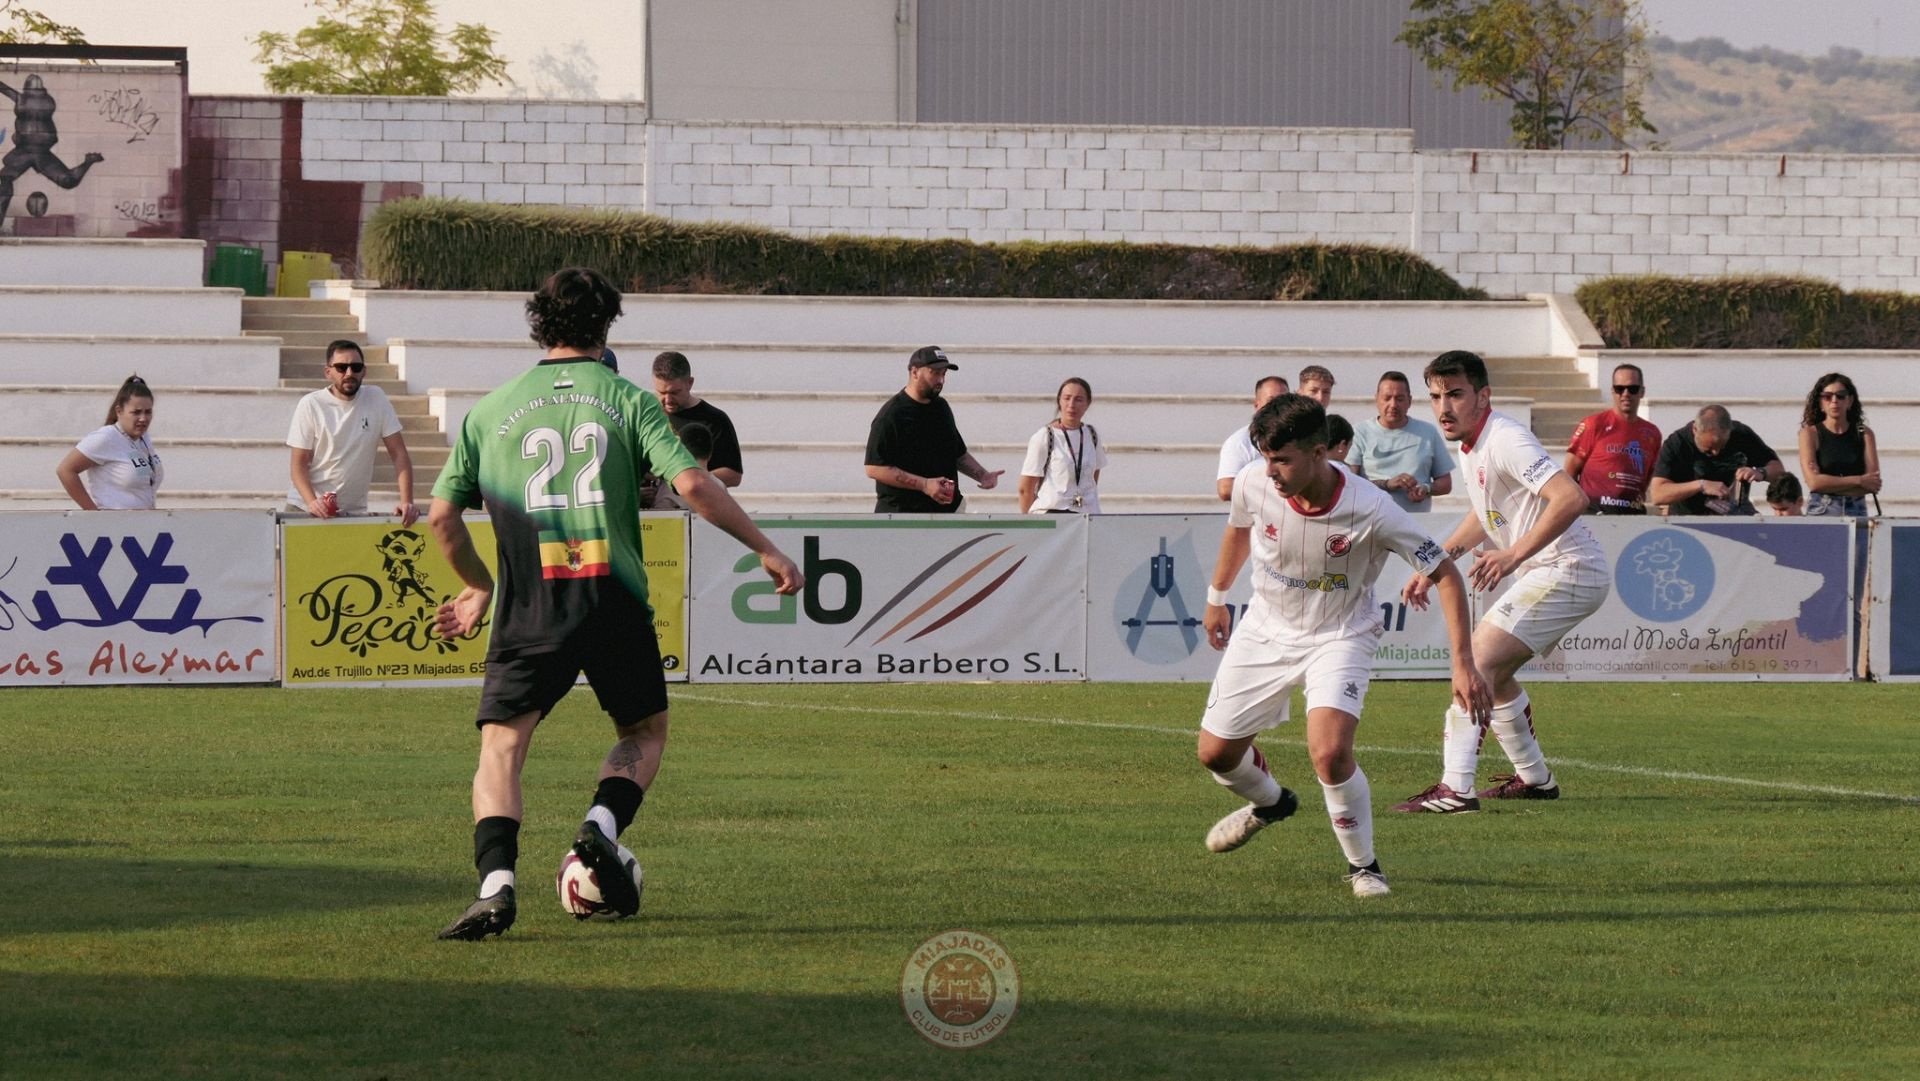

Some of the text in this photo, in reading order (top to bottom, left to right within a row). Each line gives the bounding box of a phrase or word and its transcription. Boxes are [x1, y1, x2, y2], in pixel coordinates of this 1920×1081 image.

[528, 397, 547, 411] DE
[521, 421, 609, 513] 22
[731, 536, 862, 625] ab
[1634, 626, 1700, 650] Moda
[1705, 627, 1788, 657] Infantil
[0, 640, 264, 676] as Alexmar
[700, 652, 1078, 675] Alcántara Barbero S.L.
[1375, 645, 1450, 662] Miajadas
[1730, 659, 1756, 671] 615
[1763, 659, 1778, 671] 19
[335, 665, 373, 679] Trujillo
[413, 663, 465, 677] Miajadas
